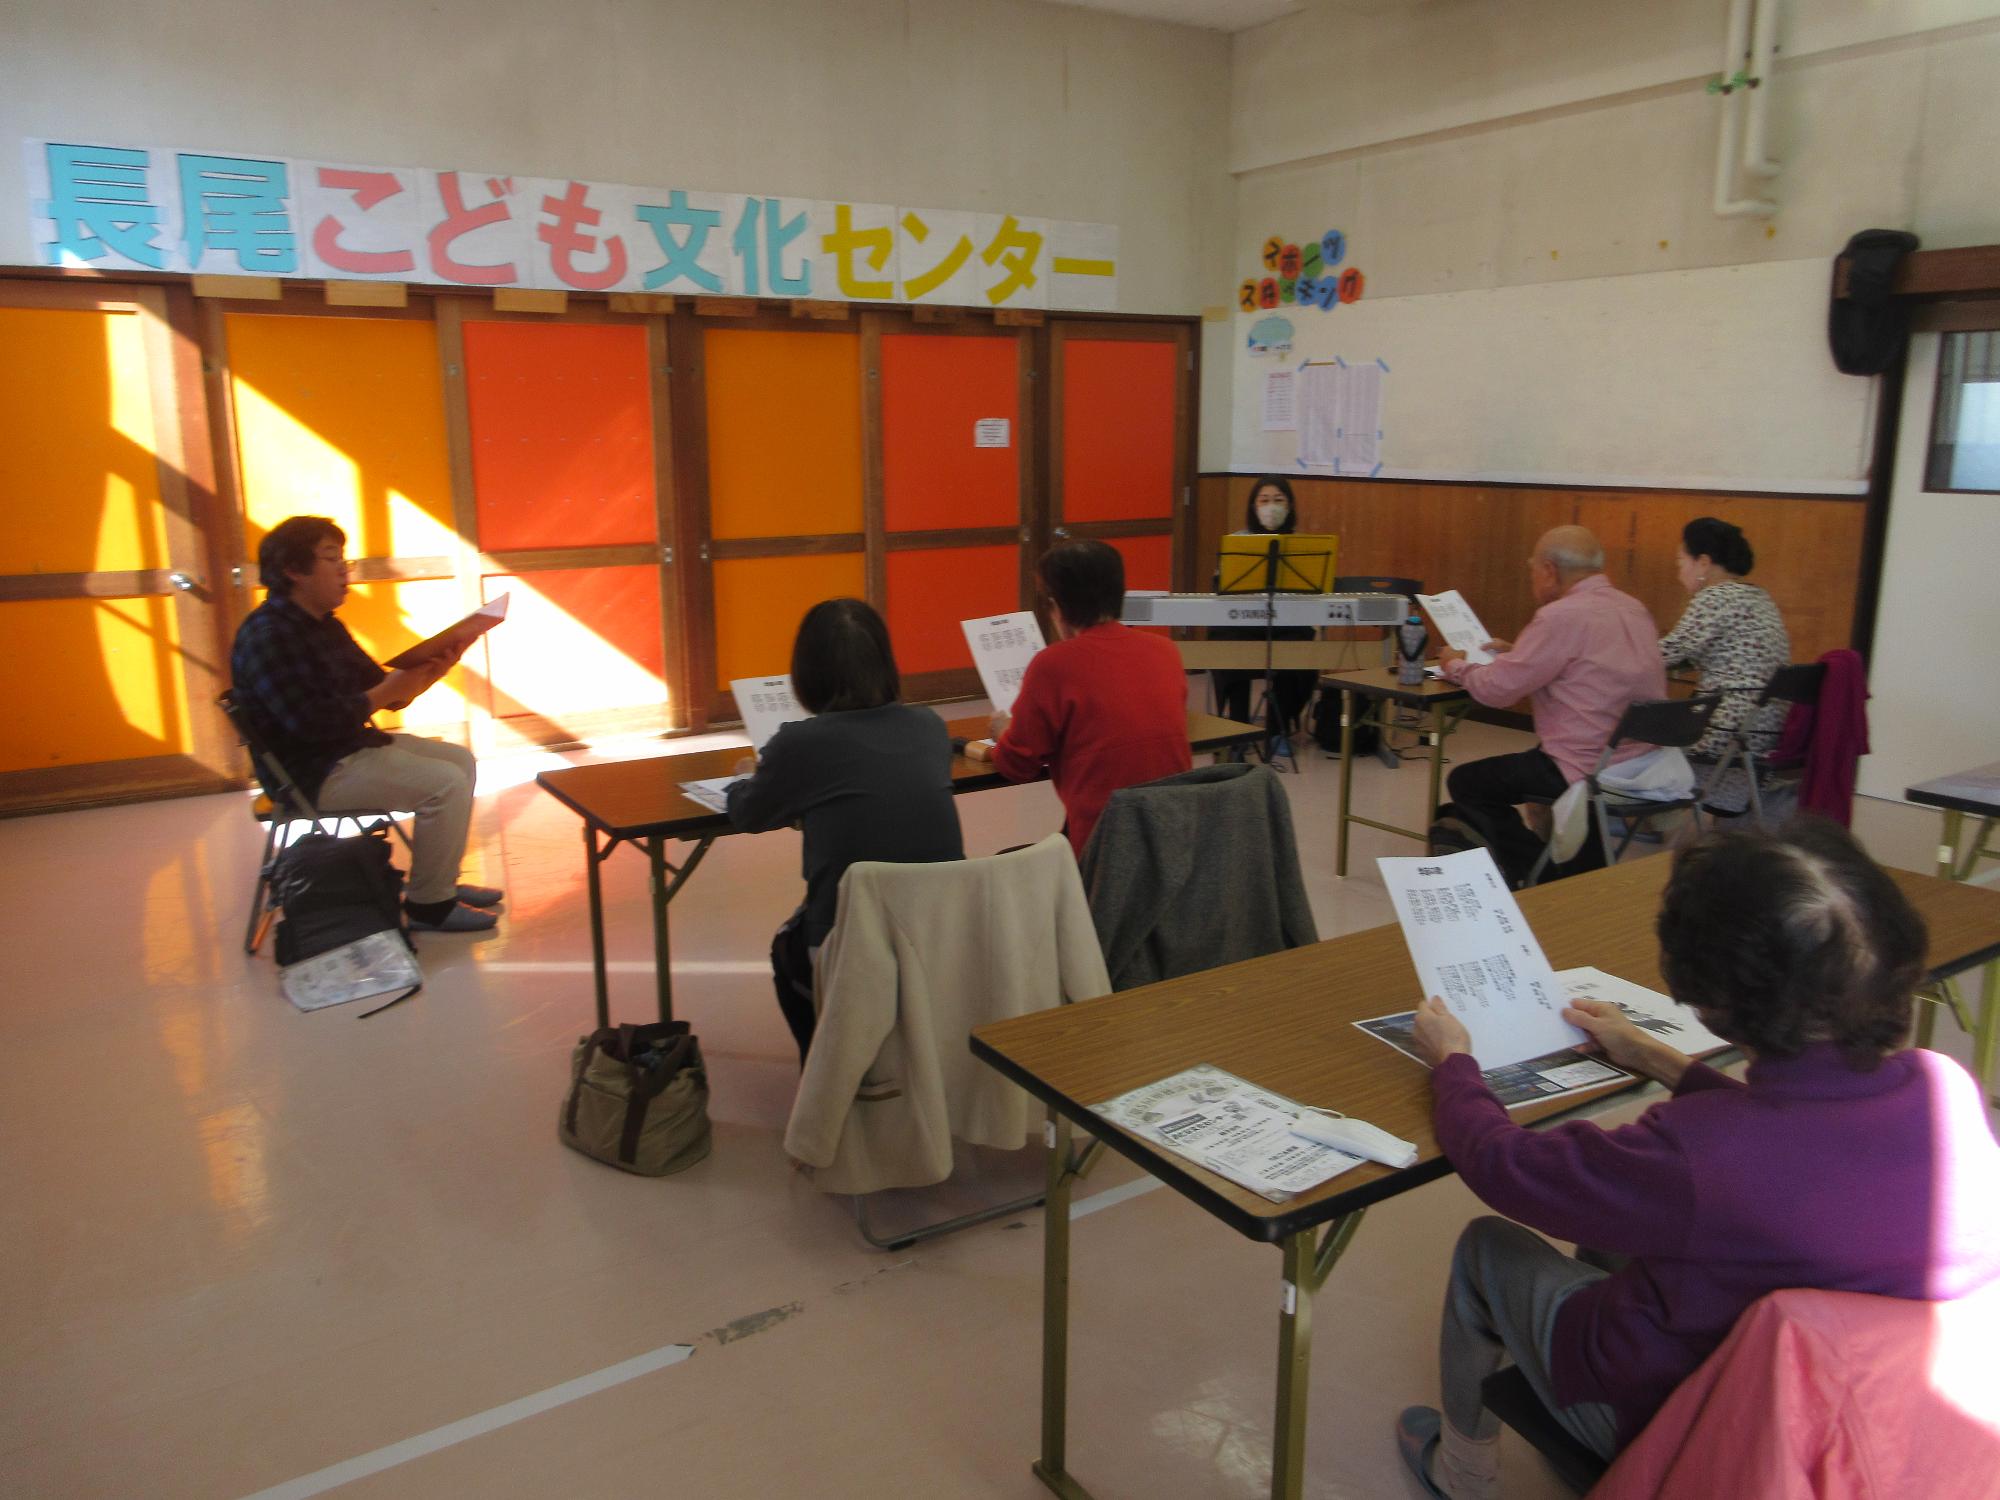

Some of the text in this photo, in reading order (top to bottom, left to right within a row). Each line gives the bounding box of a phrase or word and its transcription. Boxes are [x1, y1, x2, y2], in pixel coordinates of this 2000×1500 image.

[47, 143, 1114, 305] 長尾こども文化センター
